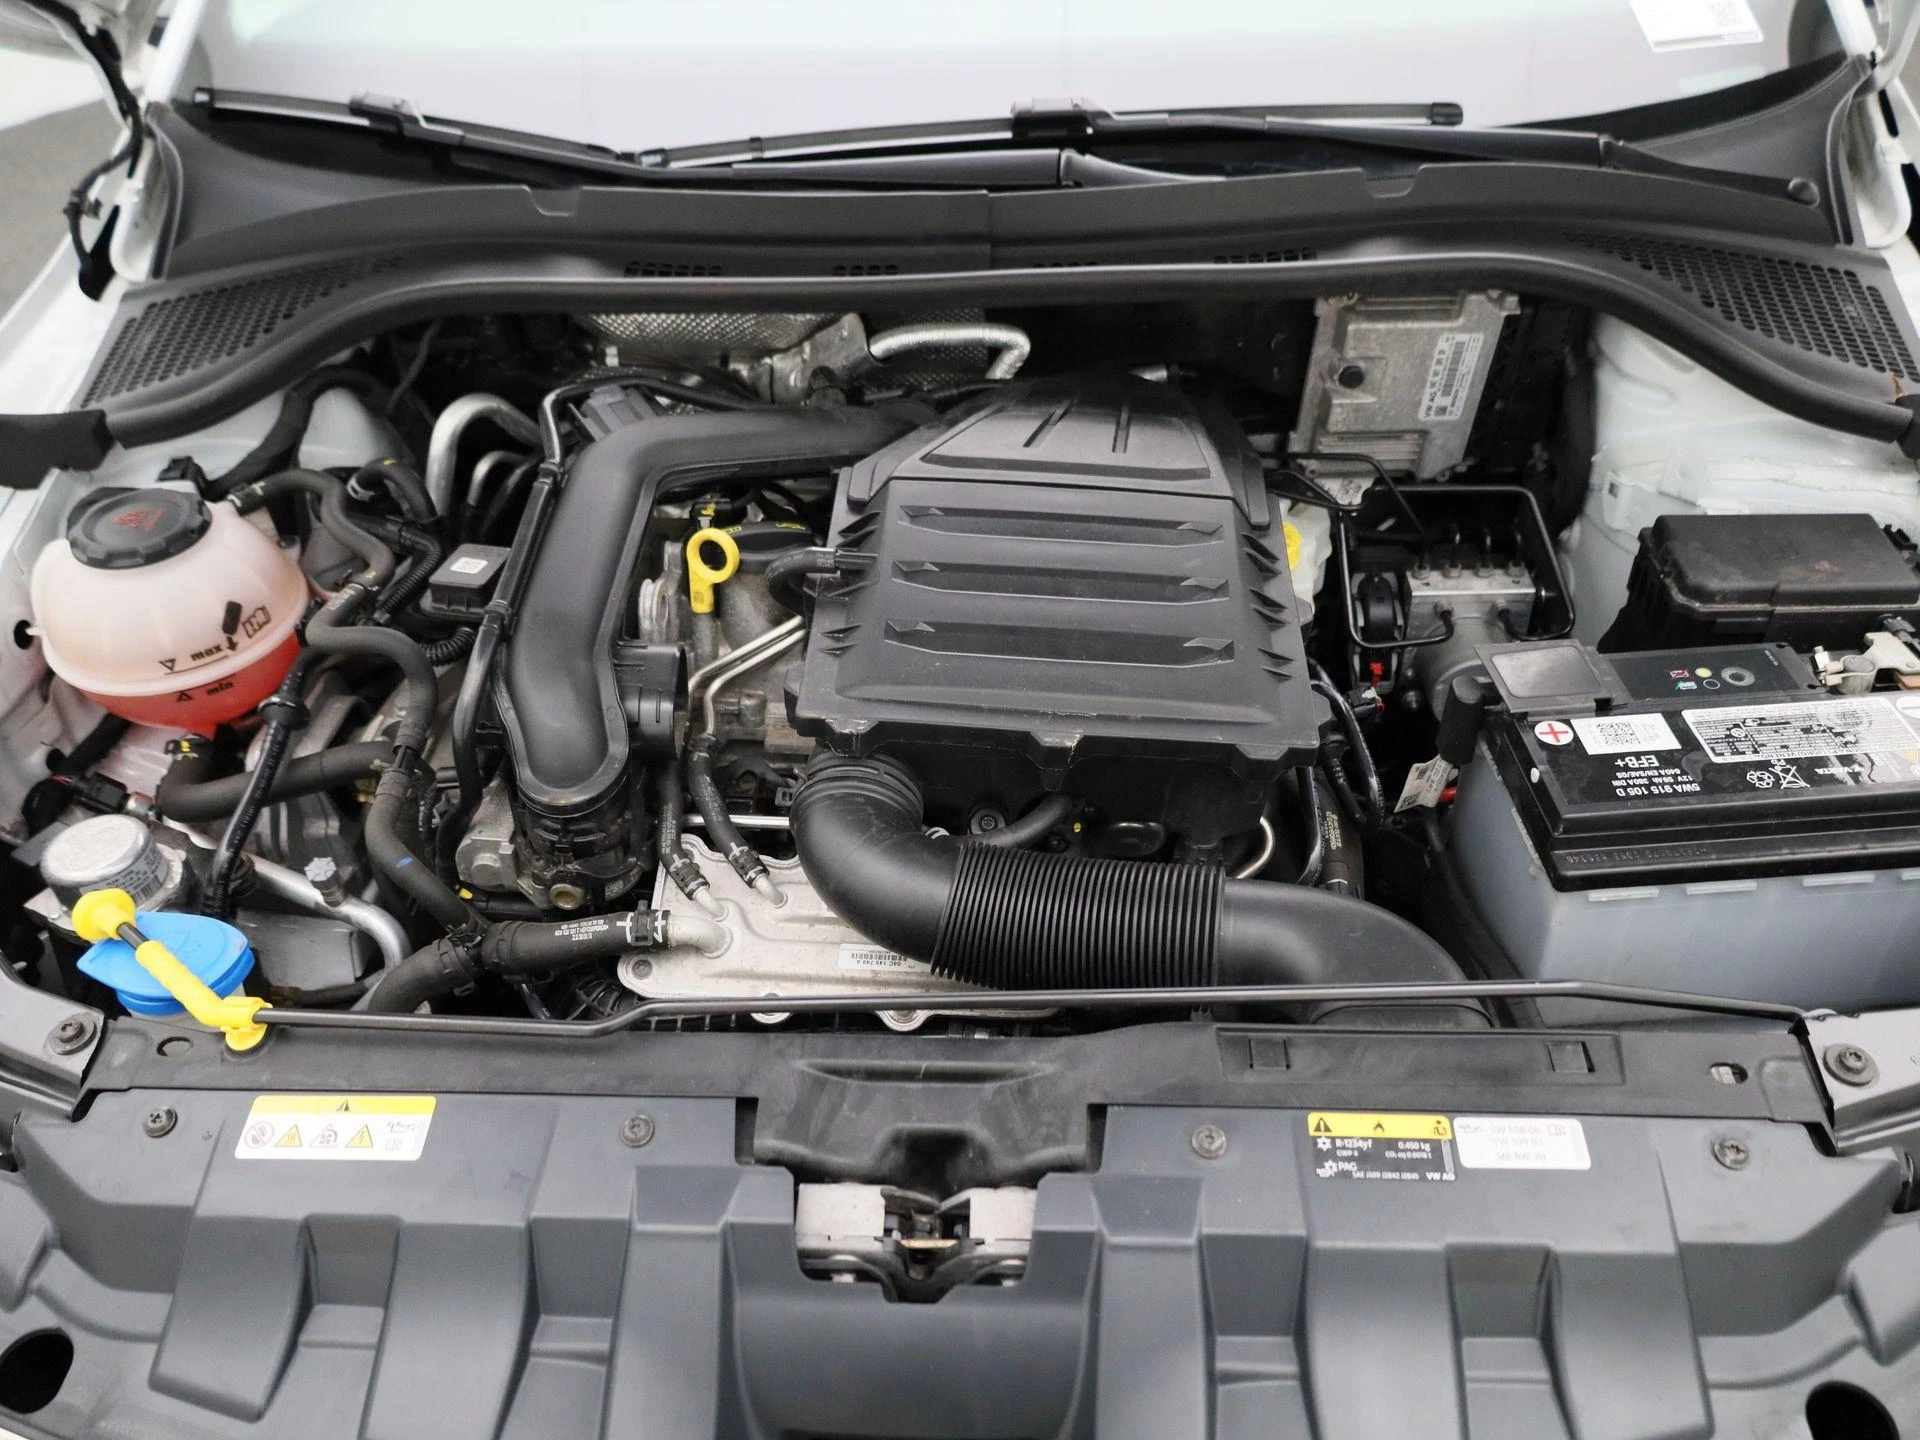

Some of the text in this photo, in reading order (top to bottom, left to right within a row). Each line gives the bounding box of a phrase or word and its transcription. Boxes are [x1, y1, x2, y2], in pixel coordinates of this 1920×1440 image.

[190, 644, 223, 661] max
[207, 682, 233, 695] min
[1615, 755, 1660, 768] EFB+
[1615, 783, 1700, 797] 5WA 915 105 D
[1335, 1138, 1372, 1151] R-1234yf
[1420, 1142, 1431, 1152] kg
[1337, 1161, 1358, 1172] PAG
[1426, 1171, 1456, 1181] VW AG
